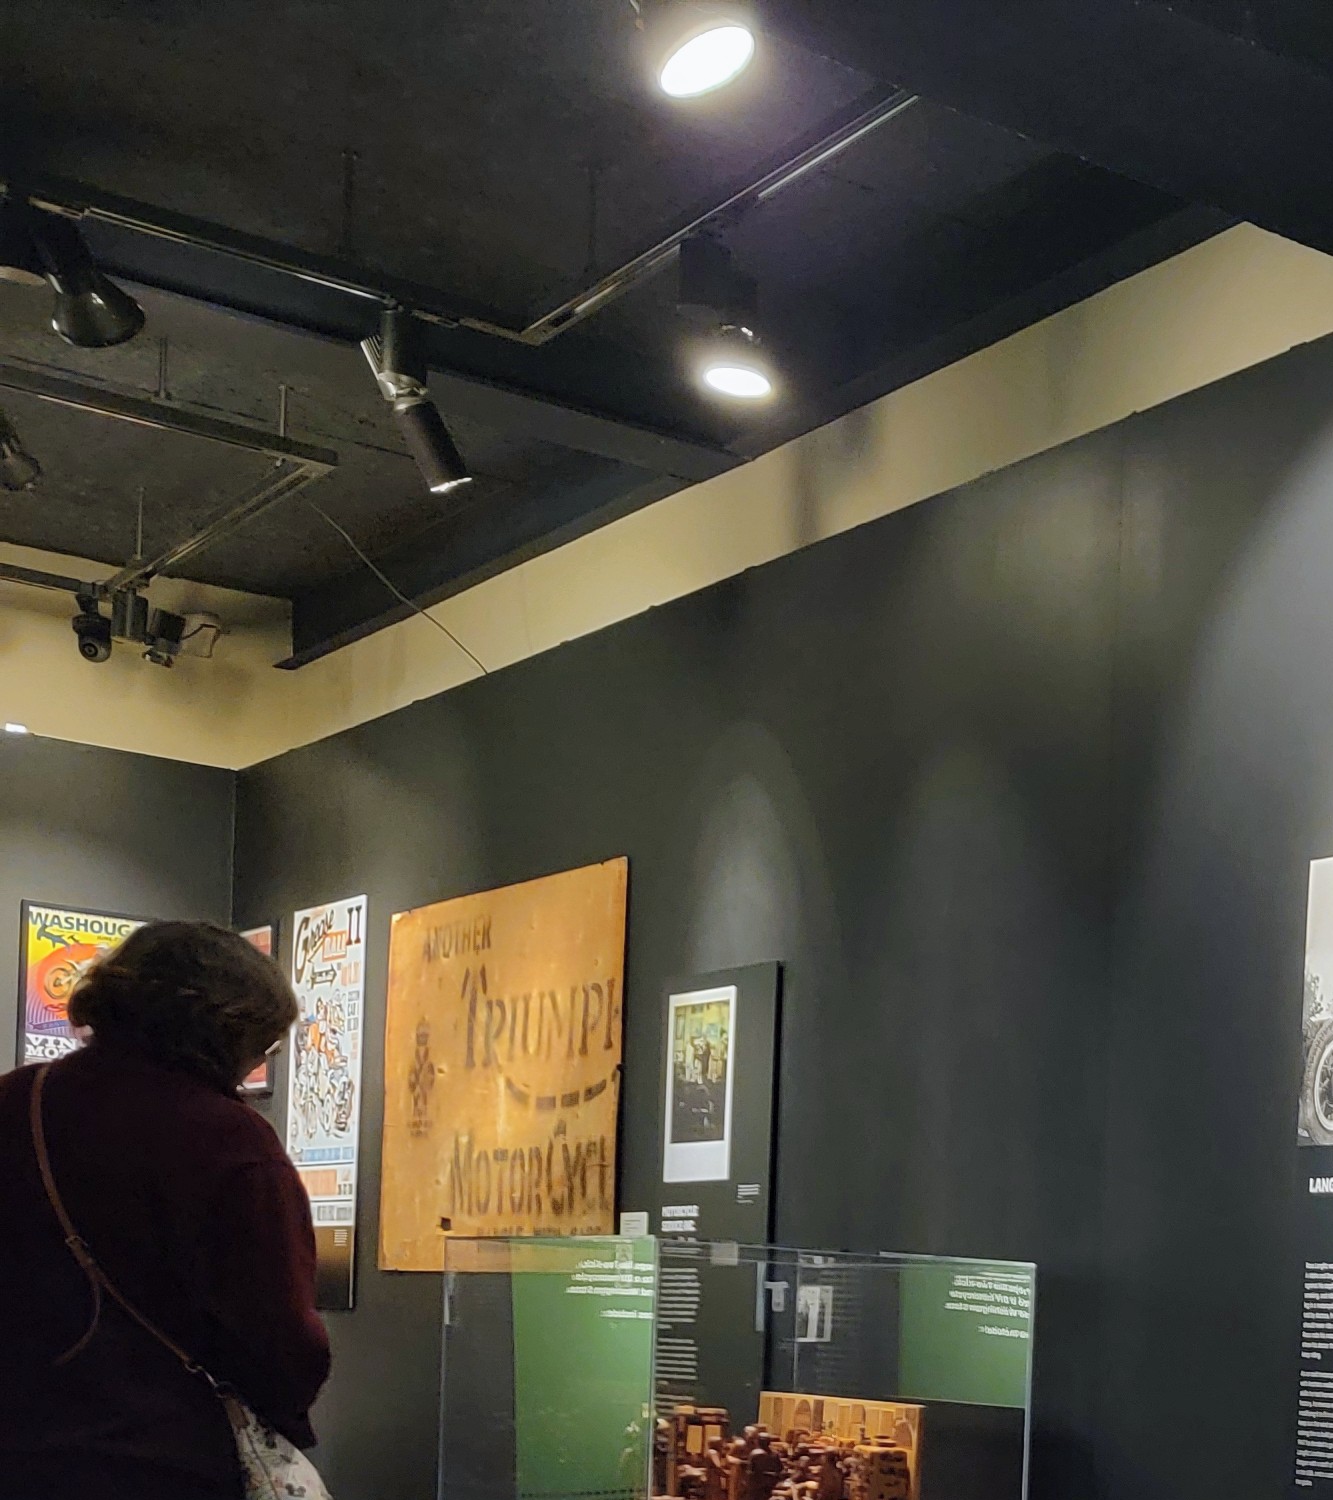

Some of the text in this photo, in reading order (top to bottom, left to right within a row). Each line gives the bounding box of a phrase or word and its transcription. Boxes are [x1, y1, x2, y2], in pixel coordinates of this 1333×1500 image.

[29, 910, 130, 938] WASHOUG
[423, 913, 492, 963] ANOTHER
[25, 1032, 77, 1051] VIN
